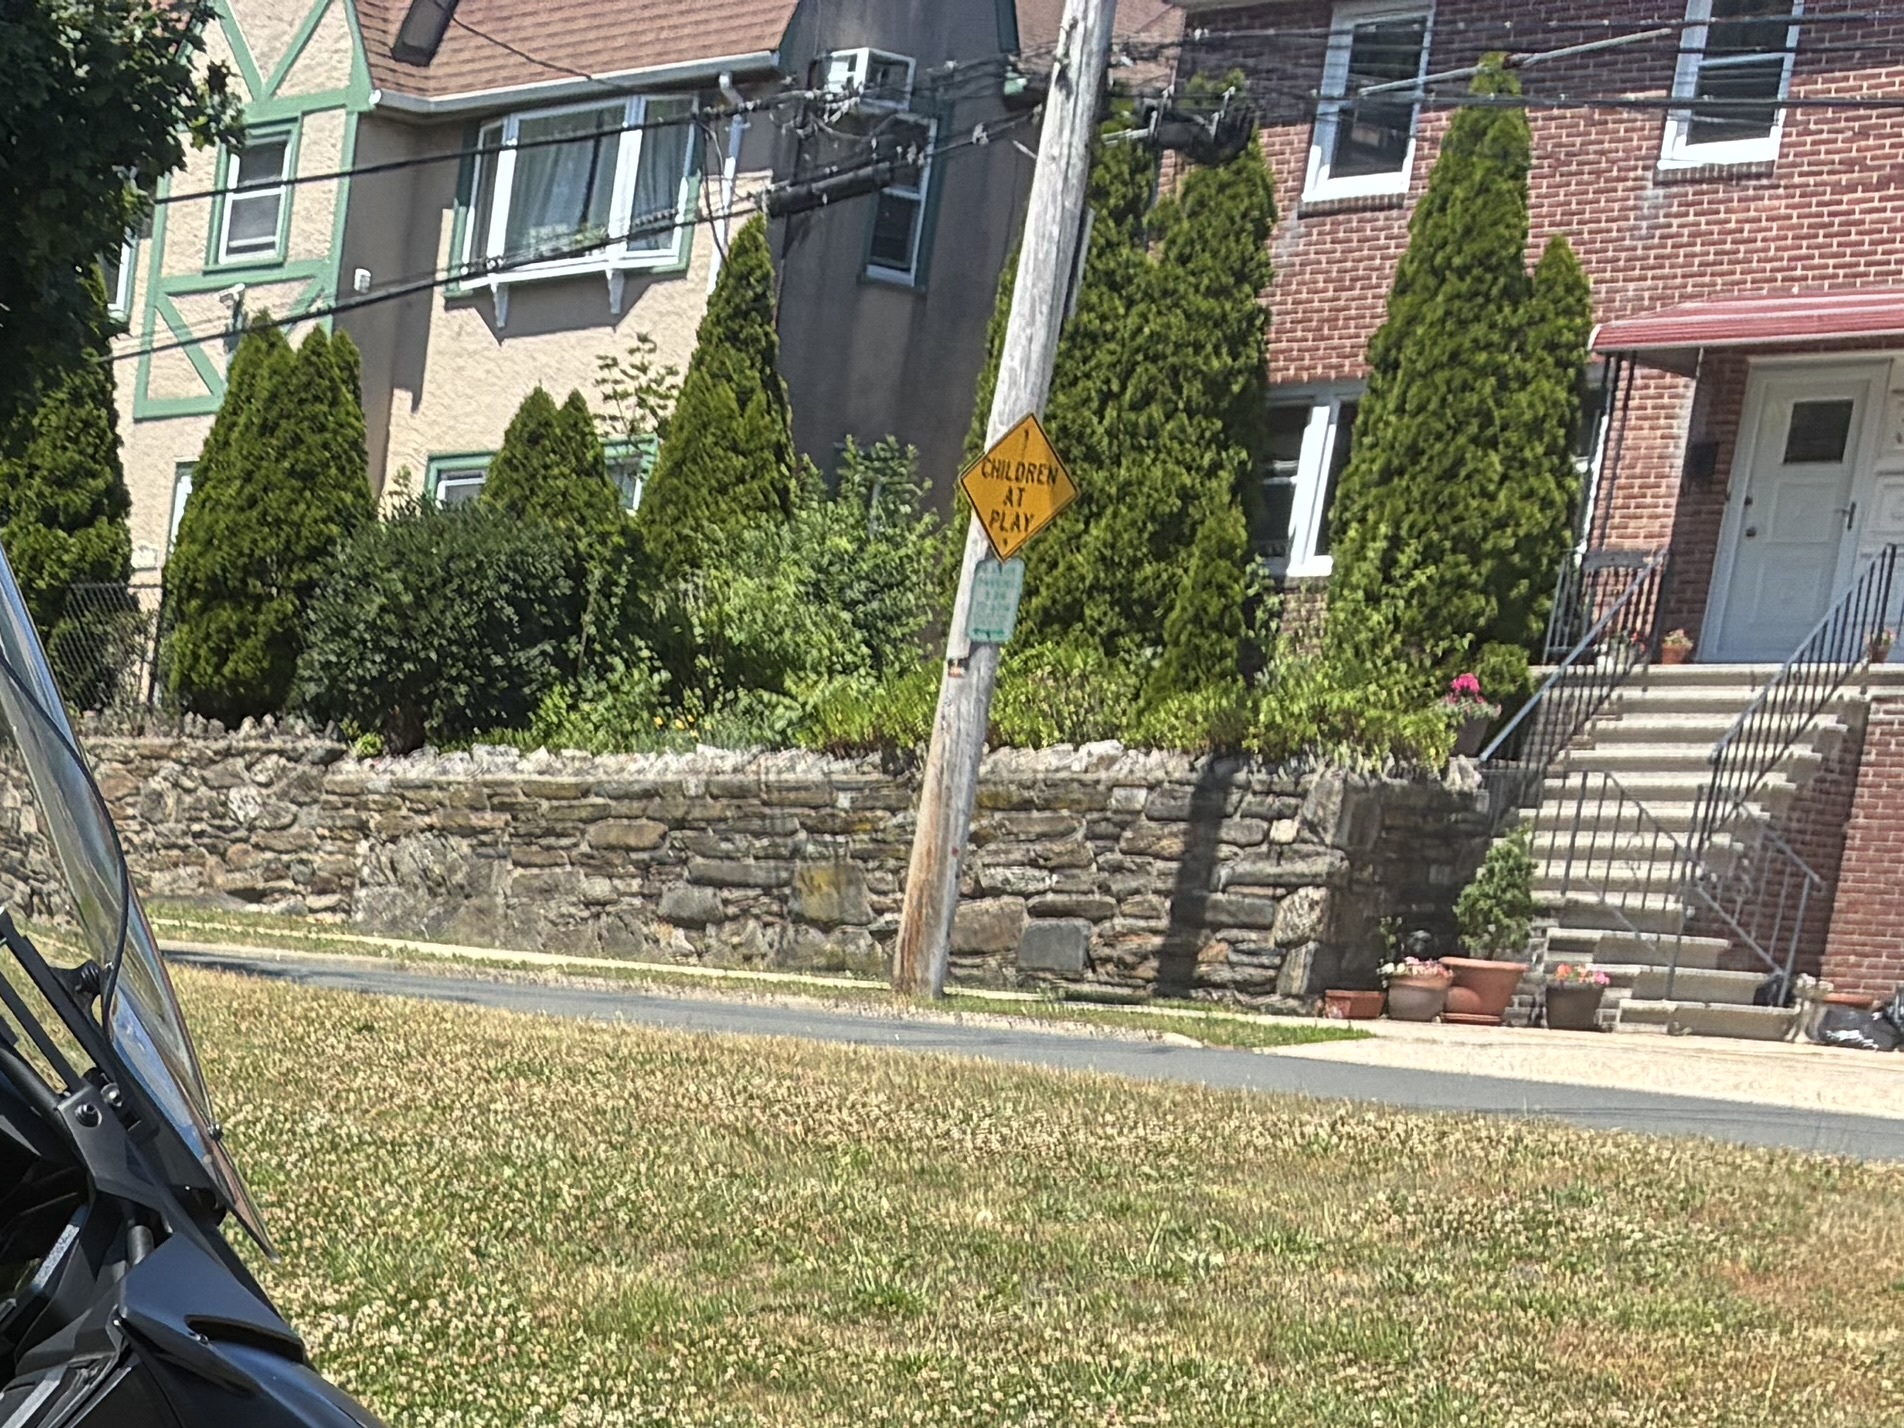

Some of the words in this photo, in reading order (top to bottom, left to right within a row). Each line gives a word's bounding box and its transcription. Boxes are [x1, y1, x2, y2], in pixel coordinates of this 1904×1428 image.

[981, 457, 1059, 485] CHILDREN
[1003, 485, 1025, 507] AT
[989, 509, 1034, 533] PLAY
